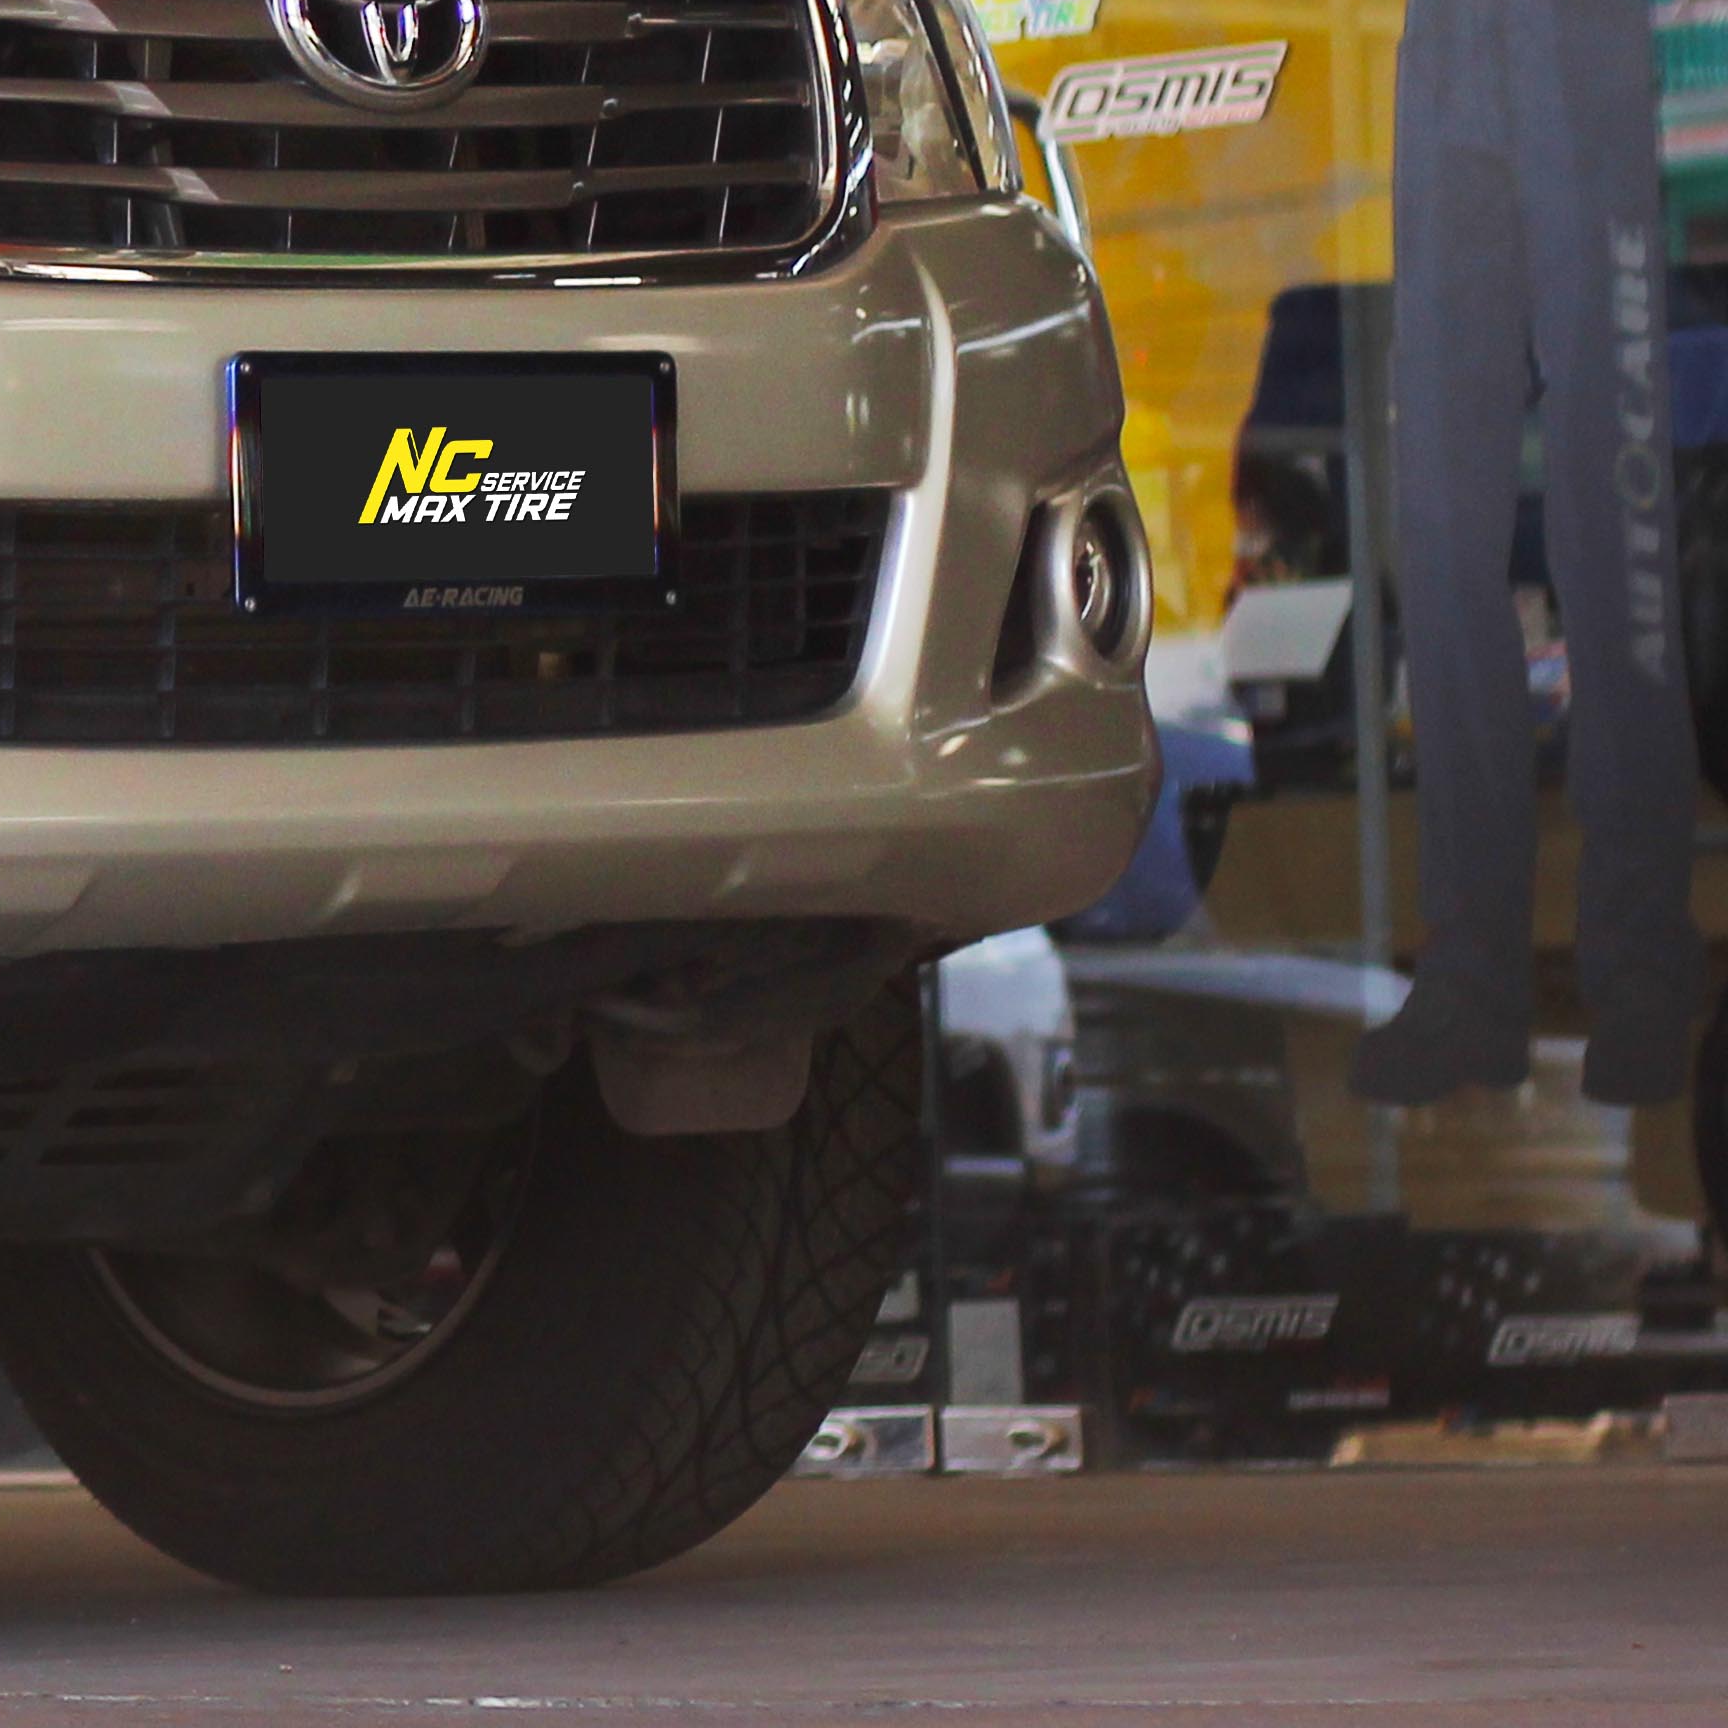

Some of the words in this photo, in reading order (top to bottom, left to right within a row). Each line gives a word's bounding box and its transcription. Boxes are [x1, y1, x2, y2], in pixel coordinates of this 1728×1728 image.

[1046, 46, 1280, 138] COSMIS
[358, 427, 494, 524] NC
[480, 470, 586, 492] SERVICE
[380, 495, 476, 524] MAX
[484, 492, 577, 522] TIRE
